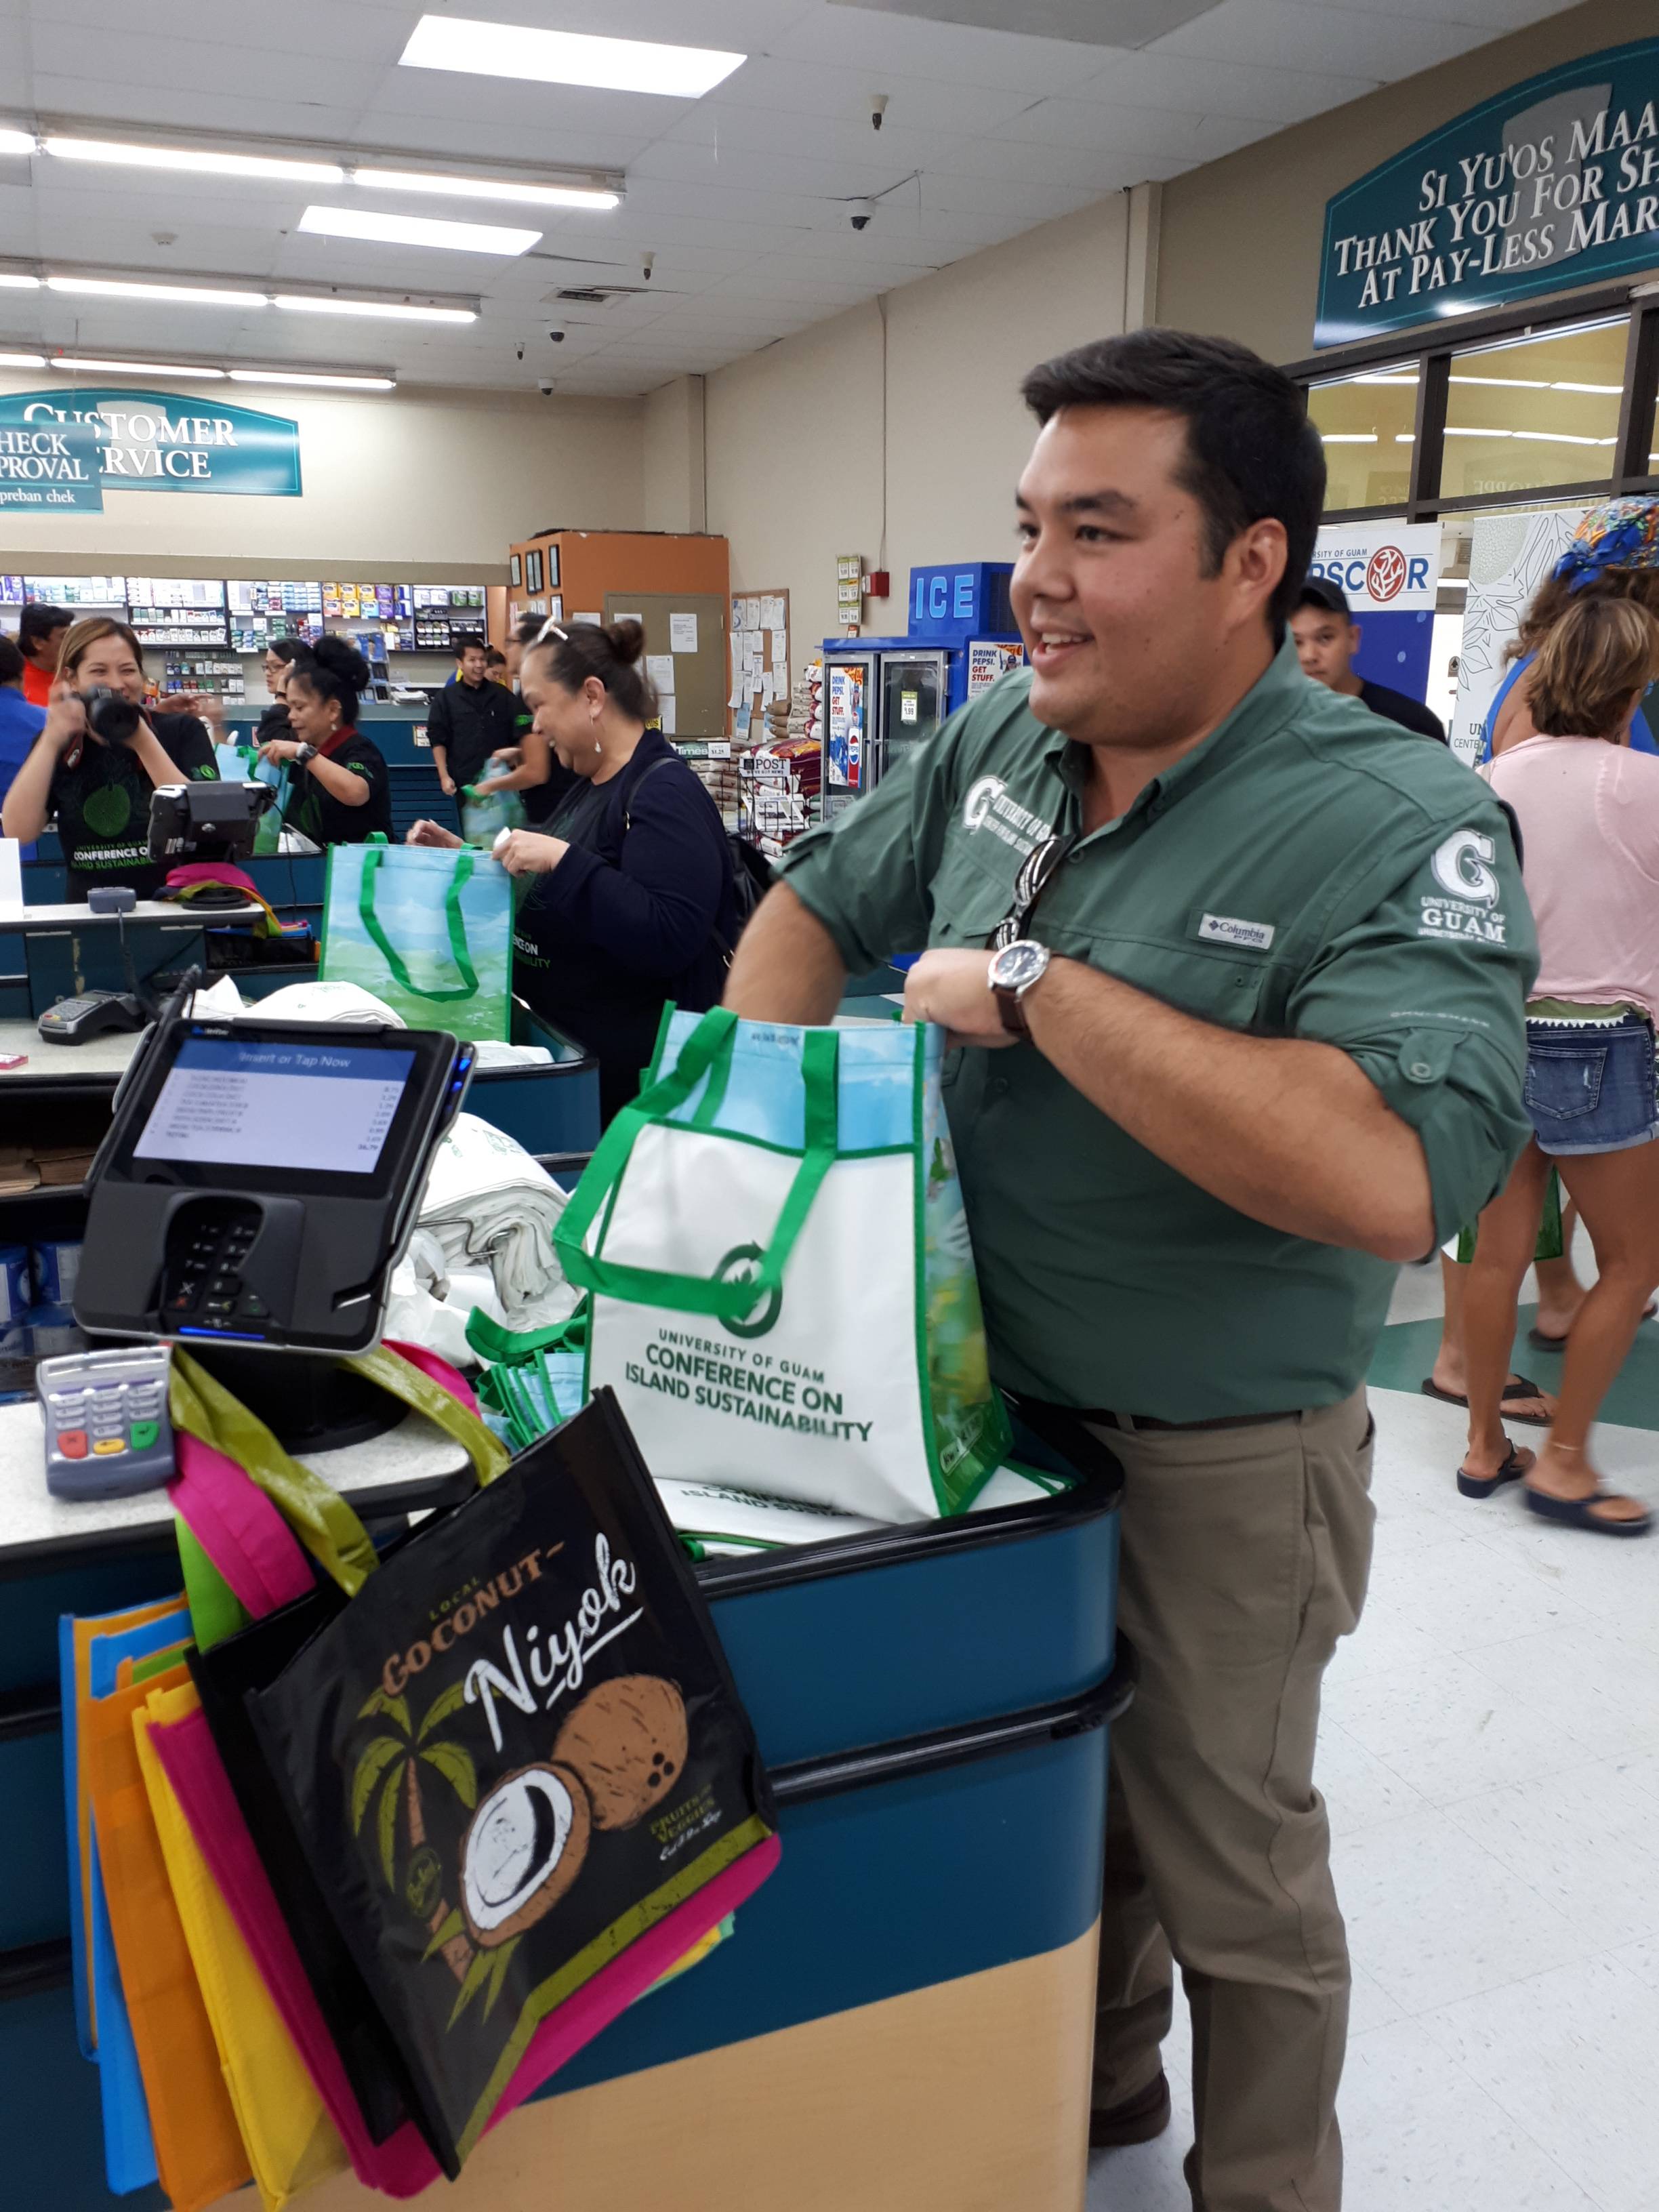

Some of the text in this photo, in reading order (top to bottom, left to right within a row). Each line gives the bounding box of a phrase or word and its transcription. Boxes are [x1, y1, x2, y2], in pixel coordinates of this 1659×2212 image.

[1334, 217, 1439, 276] THANK
[1448, 191, 1521, 243] YOU
[1530, 166, 1604, 220] FOR
[1357, 267, 1401, 308] AT
[1408, 223, 1555, 295] PAY-LESS
[46, 489, 76, 504] chek
[1346, 548, 1368, 557] GUAM
[915, 574, 975, 619] ICE
[972, 649, 997, 657] DRINK
[832, 676, 845, 684] DRINK
[971, 674, 995, 682] STUFF.
[832, 696, 840, 705] GET
[676, 746, 709, 756] Times
[755, 758, 787, 770] POST
[73, 847, 138, 861] CONFERENCE
[1219, 922, 1265, 940] Columbia
[1420, 907, 1507, 943] GUAM
[277, 1055, 292, 1065] or
[295, 1053, 319, 1068] Tap
[320, 1055, 351, 1068] Now
[659, 1328, 825, 1384] UNIVERSITY OF GUAM
[646, 1343, 844, 1416] CONFERENCE ON
[625, 1361, 874, 1443] ISLAND SUSTAINABILITY
[680, 1490, 769, 1509] ISLAND
[428, 1576, 480, 1621] LOCAL
